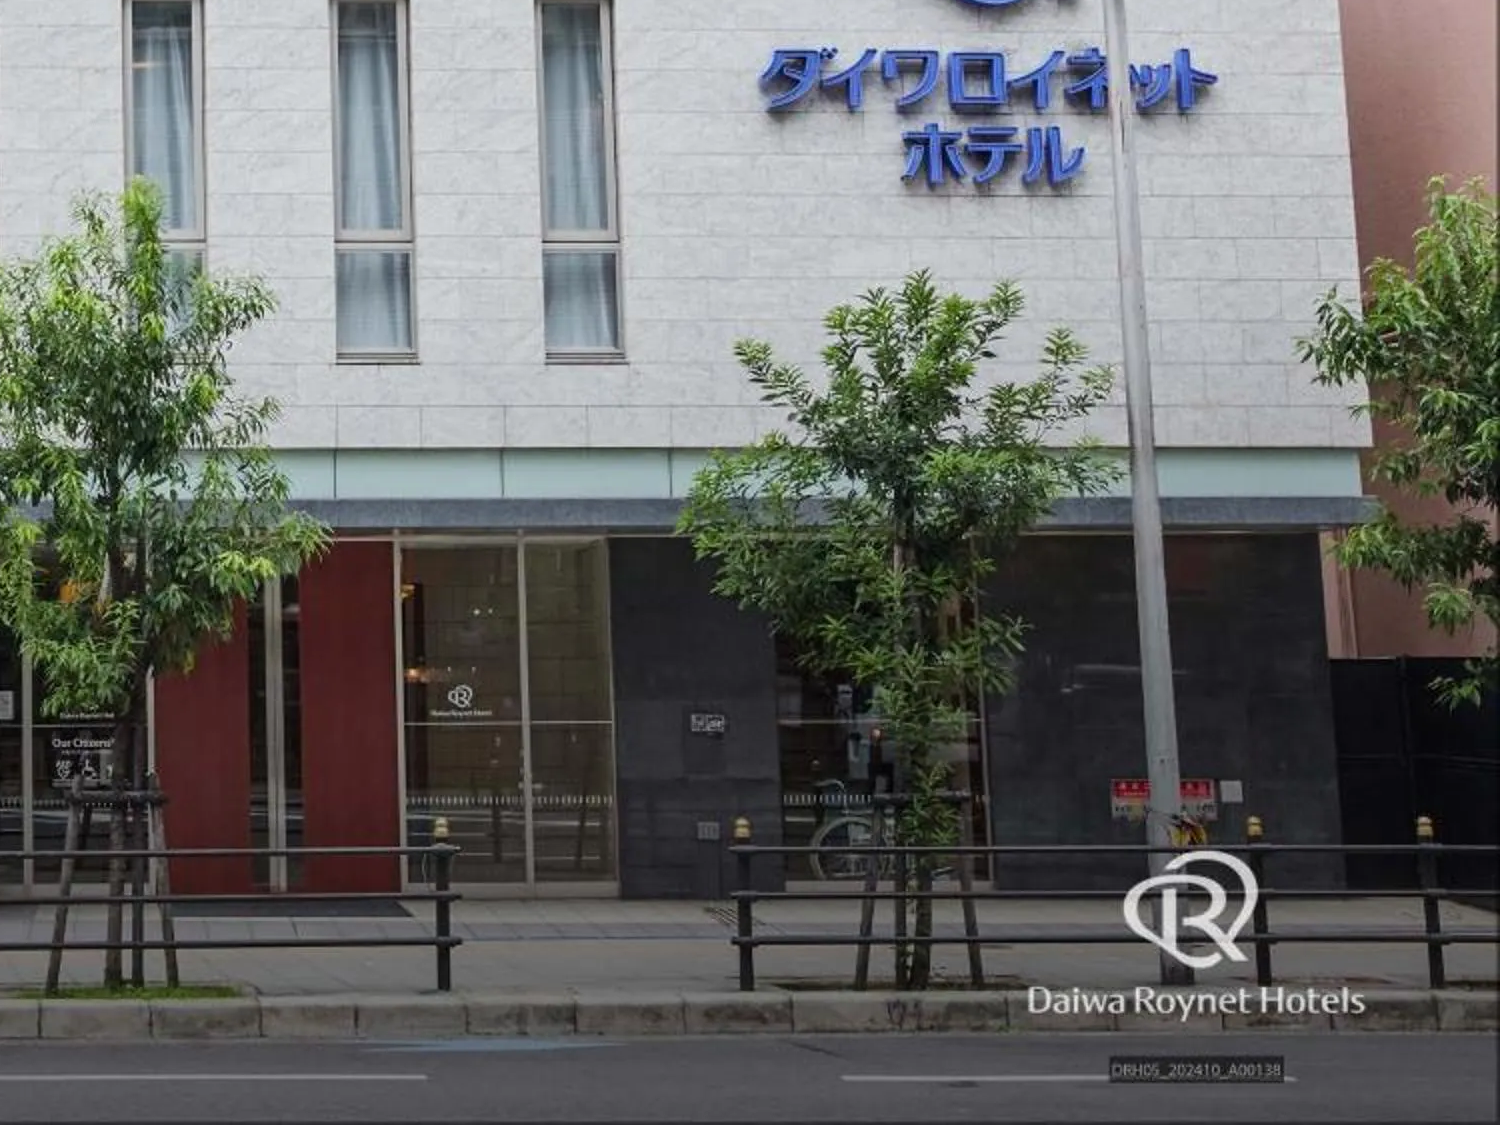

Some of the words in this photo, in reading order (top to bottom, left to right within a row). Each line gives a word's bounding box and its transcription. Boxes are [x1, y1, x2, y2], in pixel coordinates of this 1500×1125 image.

[759, 48, 1219, 112] ダイワロイネット
[901, 123, 1086, 188] ホテル
